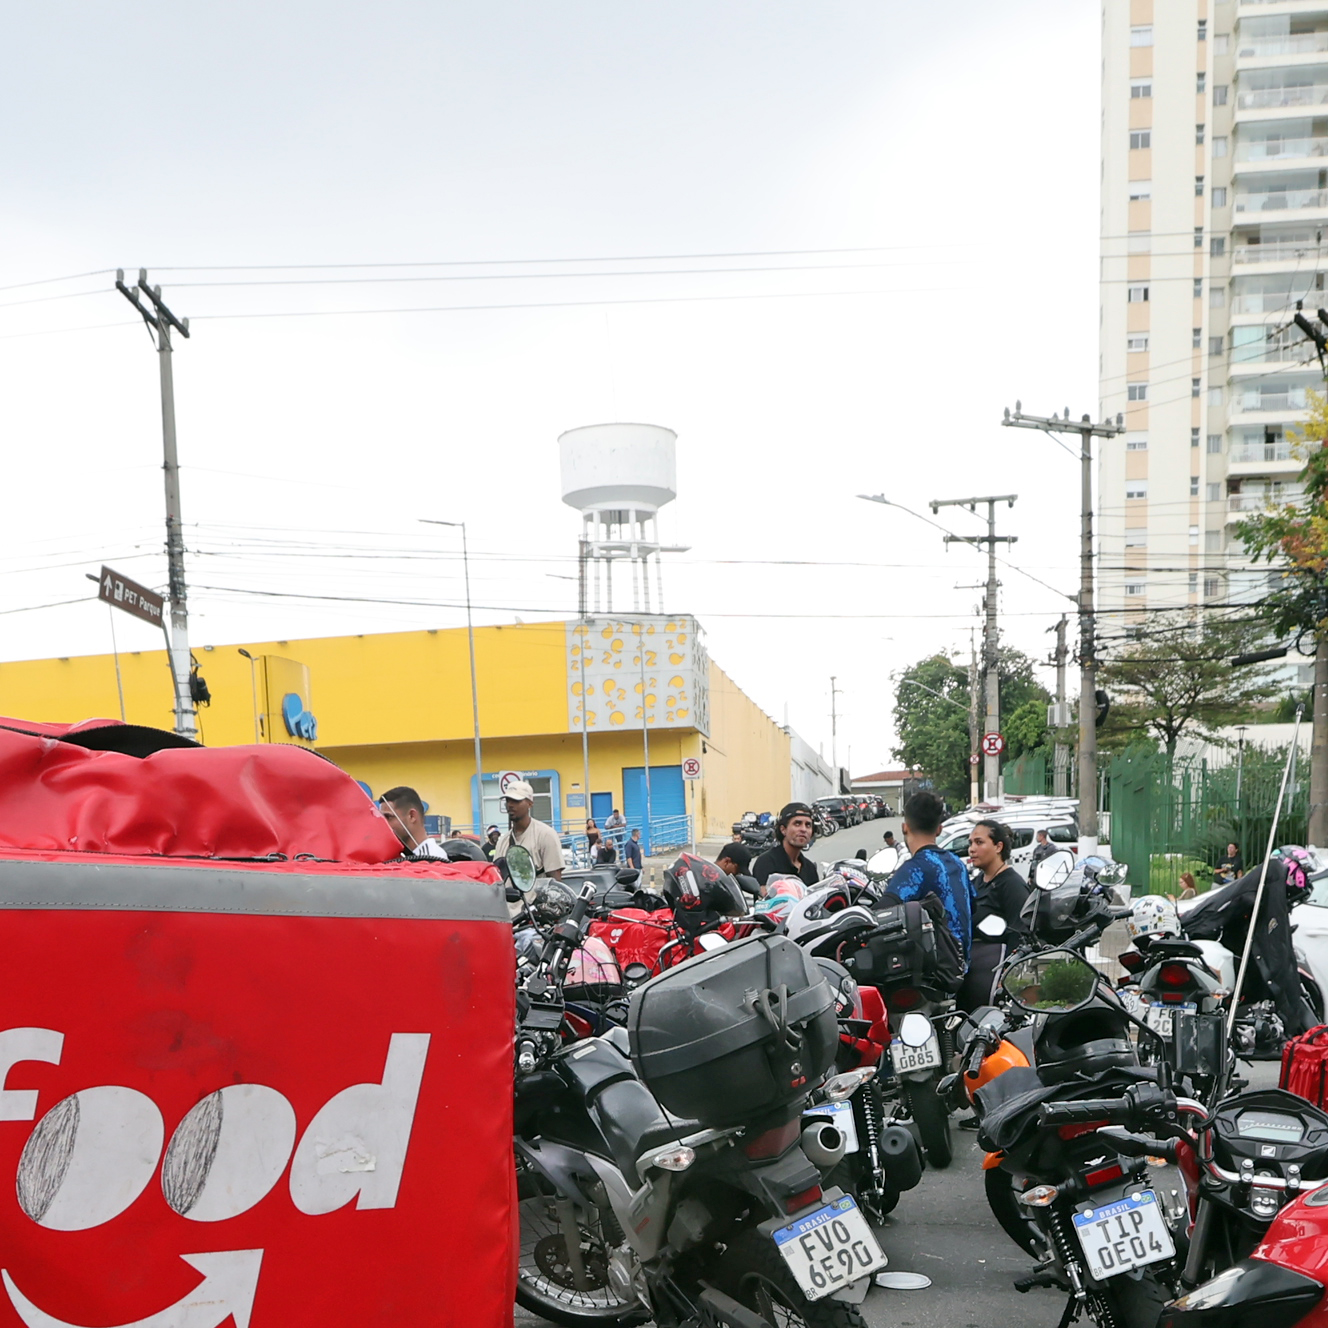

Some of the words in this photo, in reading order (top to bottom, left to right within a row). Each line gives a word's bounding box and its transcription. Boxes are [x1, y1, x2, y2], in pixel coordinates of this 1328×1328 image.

[124, 588, 138, 606] PET
[139, 596, 161, 617] Parque
[1098, 1203, 1132, 1220] BRASIL
[798, 1212, 832, 1233] BRASIL
[1095, 1210, 1144, 1244] TIP
[805, 1287, 819, 1300] BR
